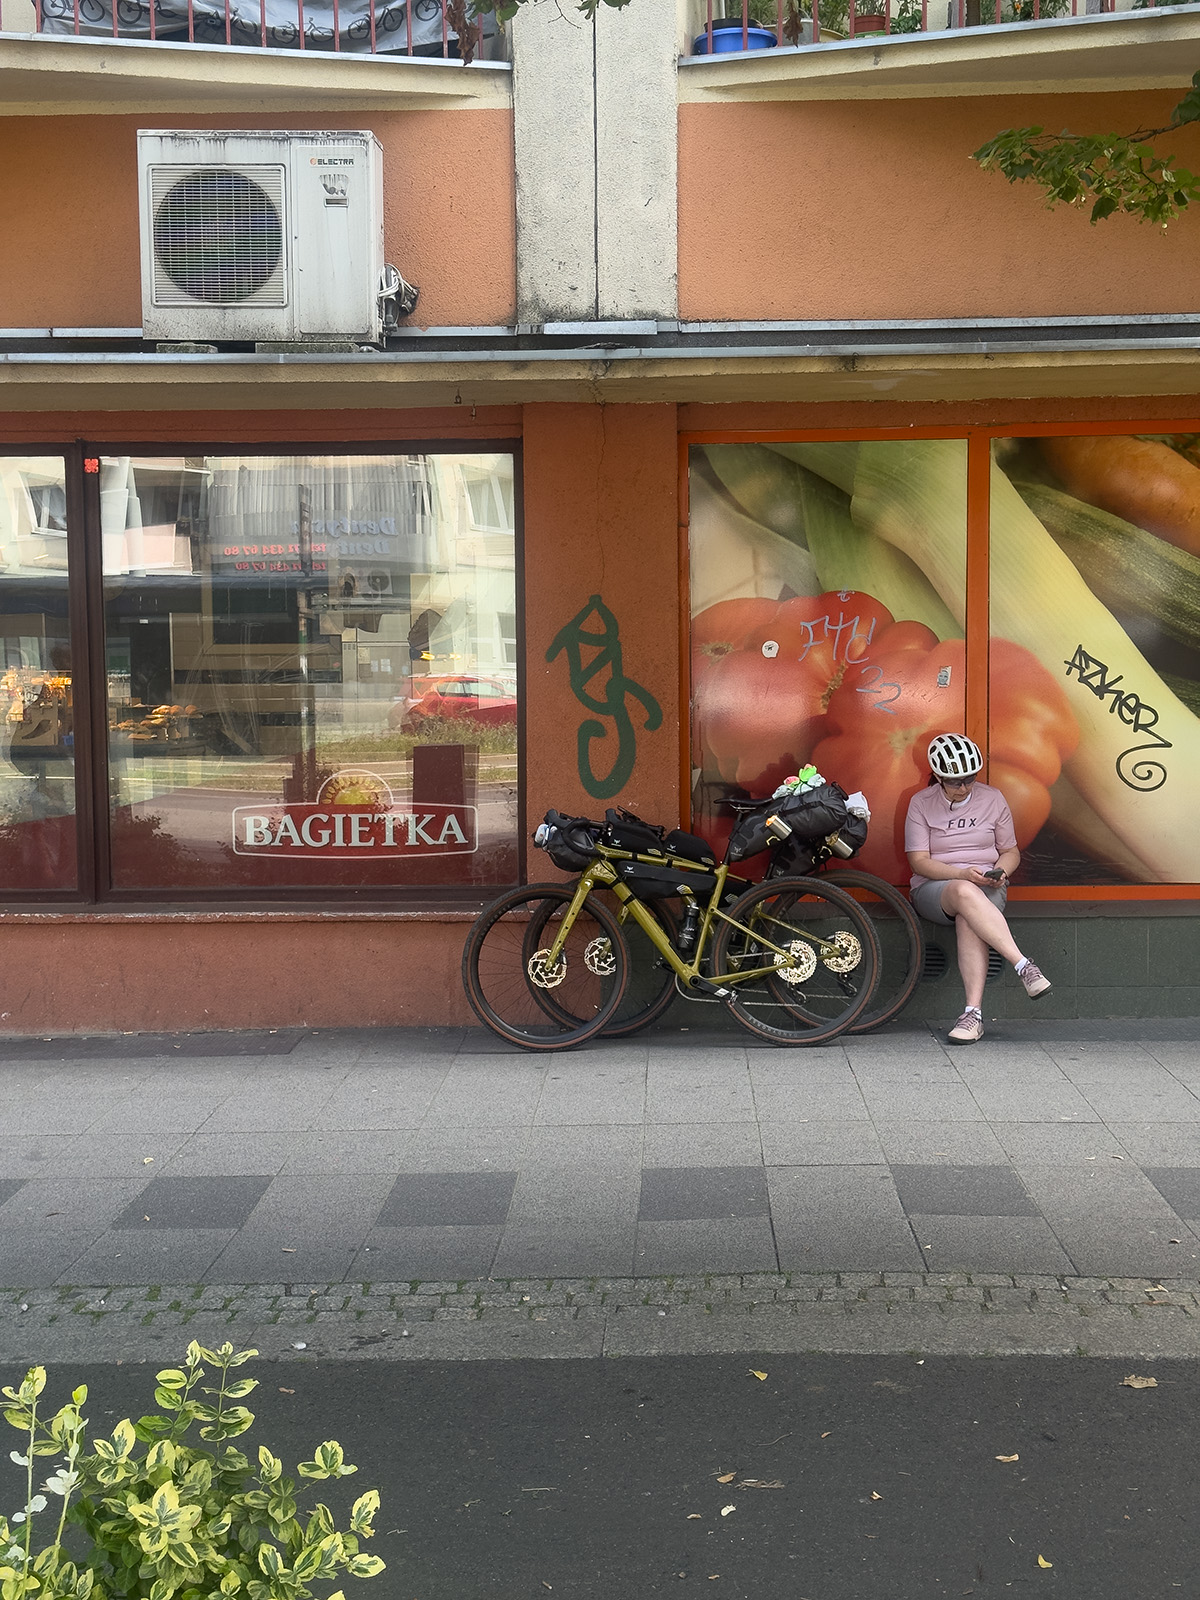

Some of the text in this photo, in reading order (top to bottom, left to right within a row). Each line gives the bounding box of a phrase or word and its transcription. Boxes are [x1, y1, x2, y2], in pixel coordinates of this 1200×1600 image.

[317, 158, 354, 166] ELECTRA
[947, 817, 977, 829] FOX
[243, 813, 469, 847] BAGIETKA
